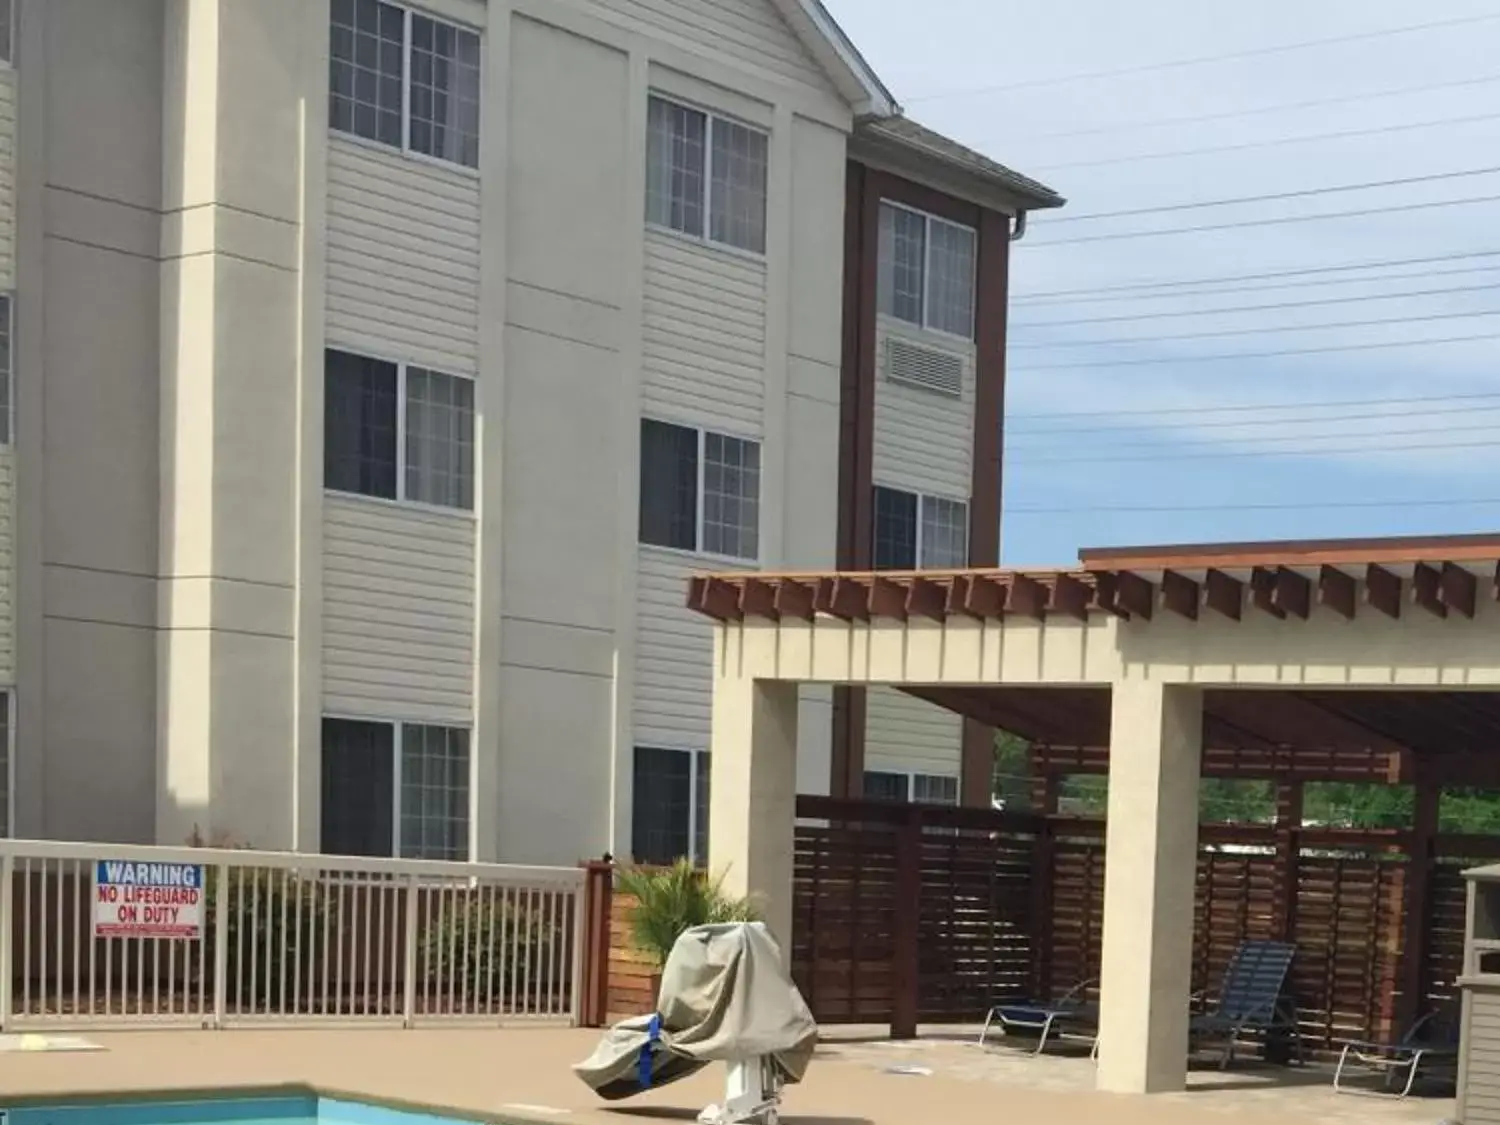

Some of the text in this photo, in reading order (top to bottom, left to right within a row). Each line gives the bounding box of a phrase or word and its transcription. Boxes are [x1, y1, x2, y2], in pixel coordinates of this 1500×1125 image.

[105, 861, 196, 886] WARNING
[97, 886, 199, 905] NO LIFEGUARD
[118, 905, 179, 924] ON DUTY
